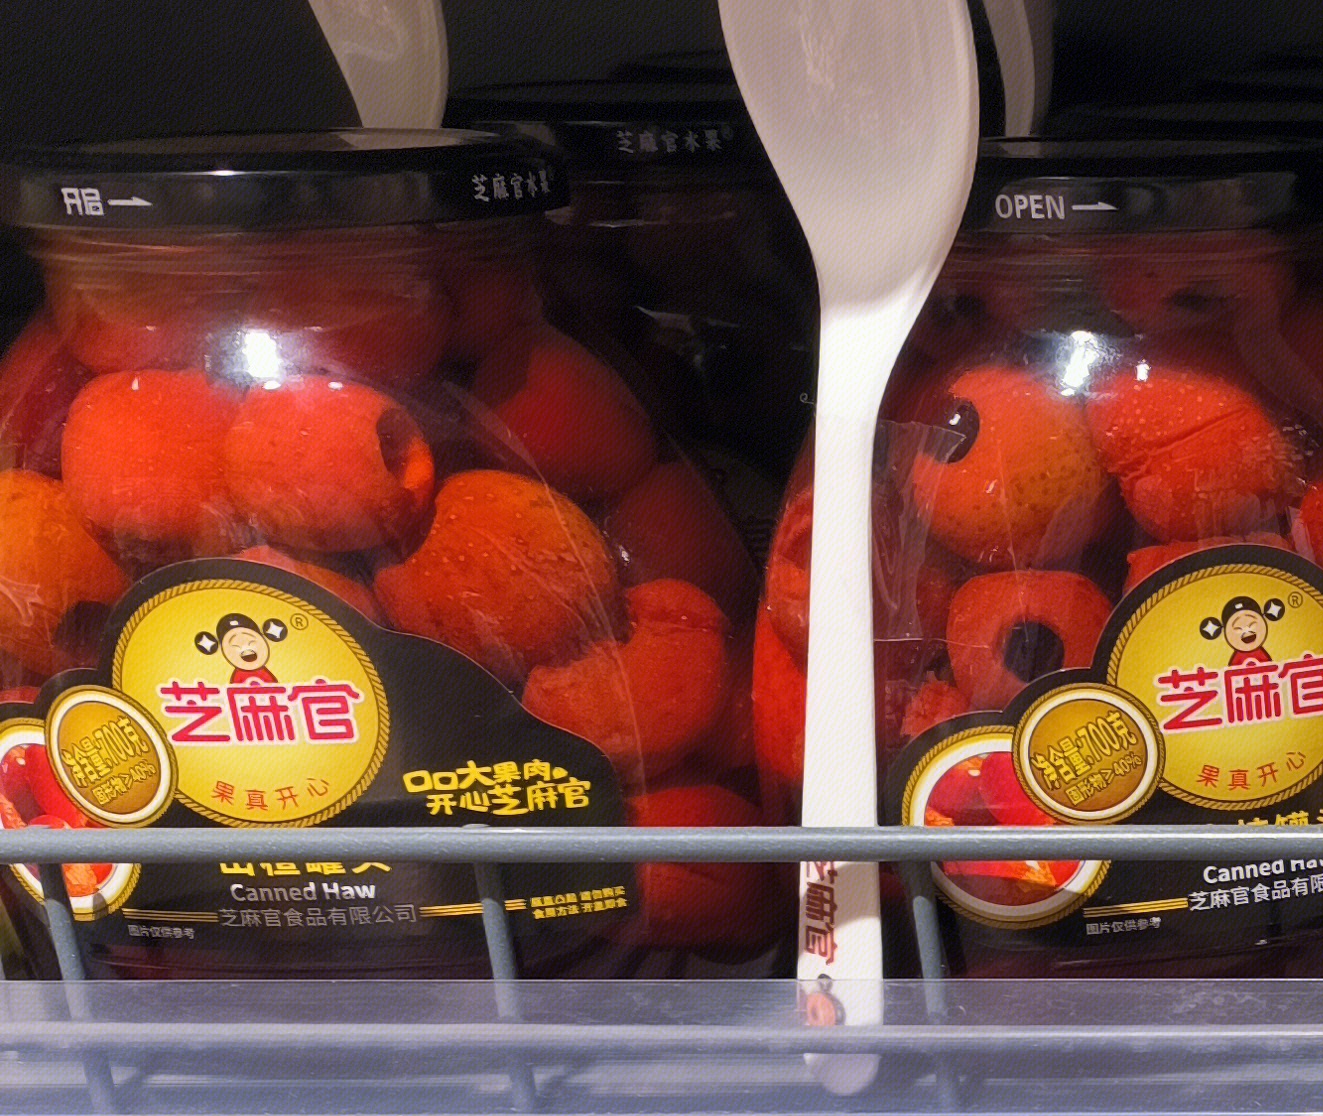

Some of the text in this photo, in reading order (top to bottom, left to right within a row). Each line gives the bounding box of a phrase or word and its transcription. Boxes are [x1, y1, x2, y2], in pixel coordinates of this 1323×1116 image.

[995, 194, 1066, 220] OPEN
[159, 678, 361, 745] 芝麻官
[1195, 749, 1308, 791] 果真开心
[211, 777, 330, 811] 果真开心
[426, 776, 591, 816] 开心芝麻官
[1203, 860, 1284, 884] Canned
[230, 882, 376, 902] Canned Haw
[218, 904, 419, 928] 芝麻官食品有限公司
